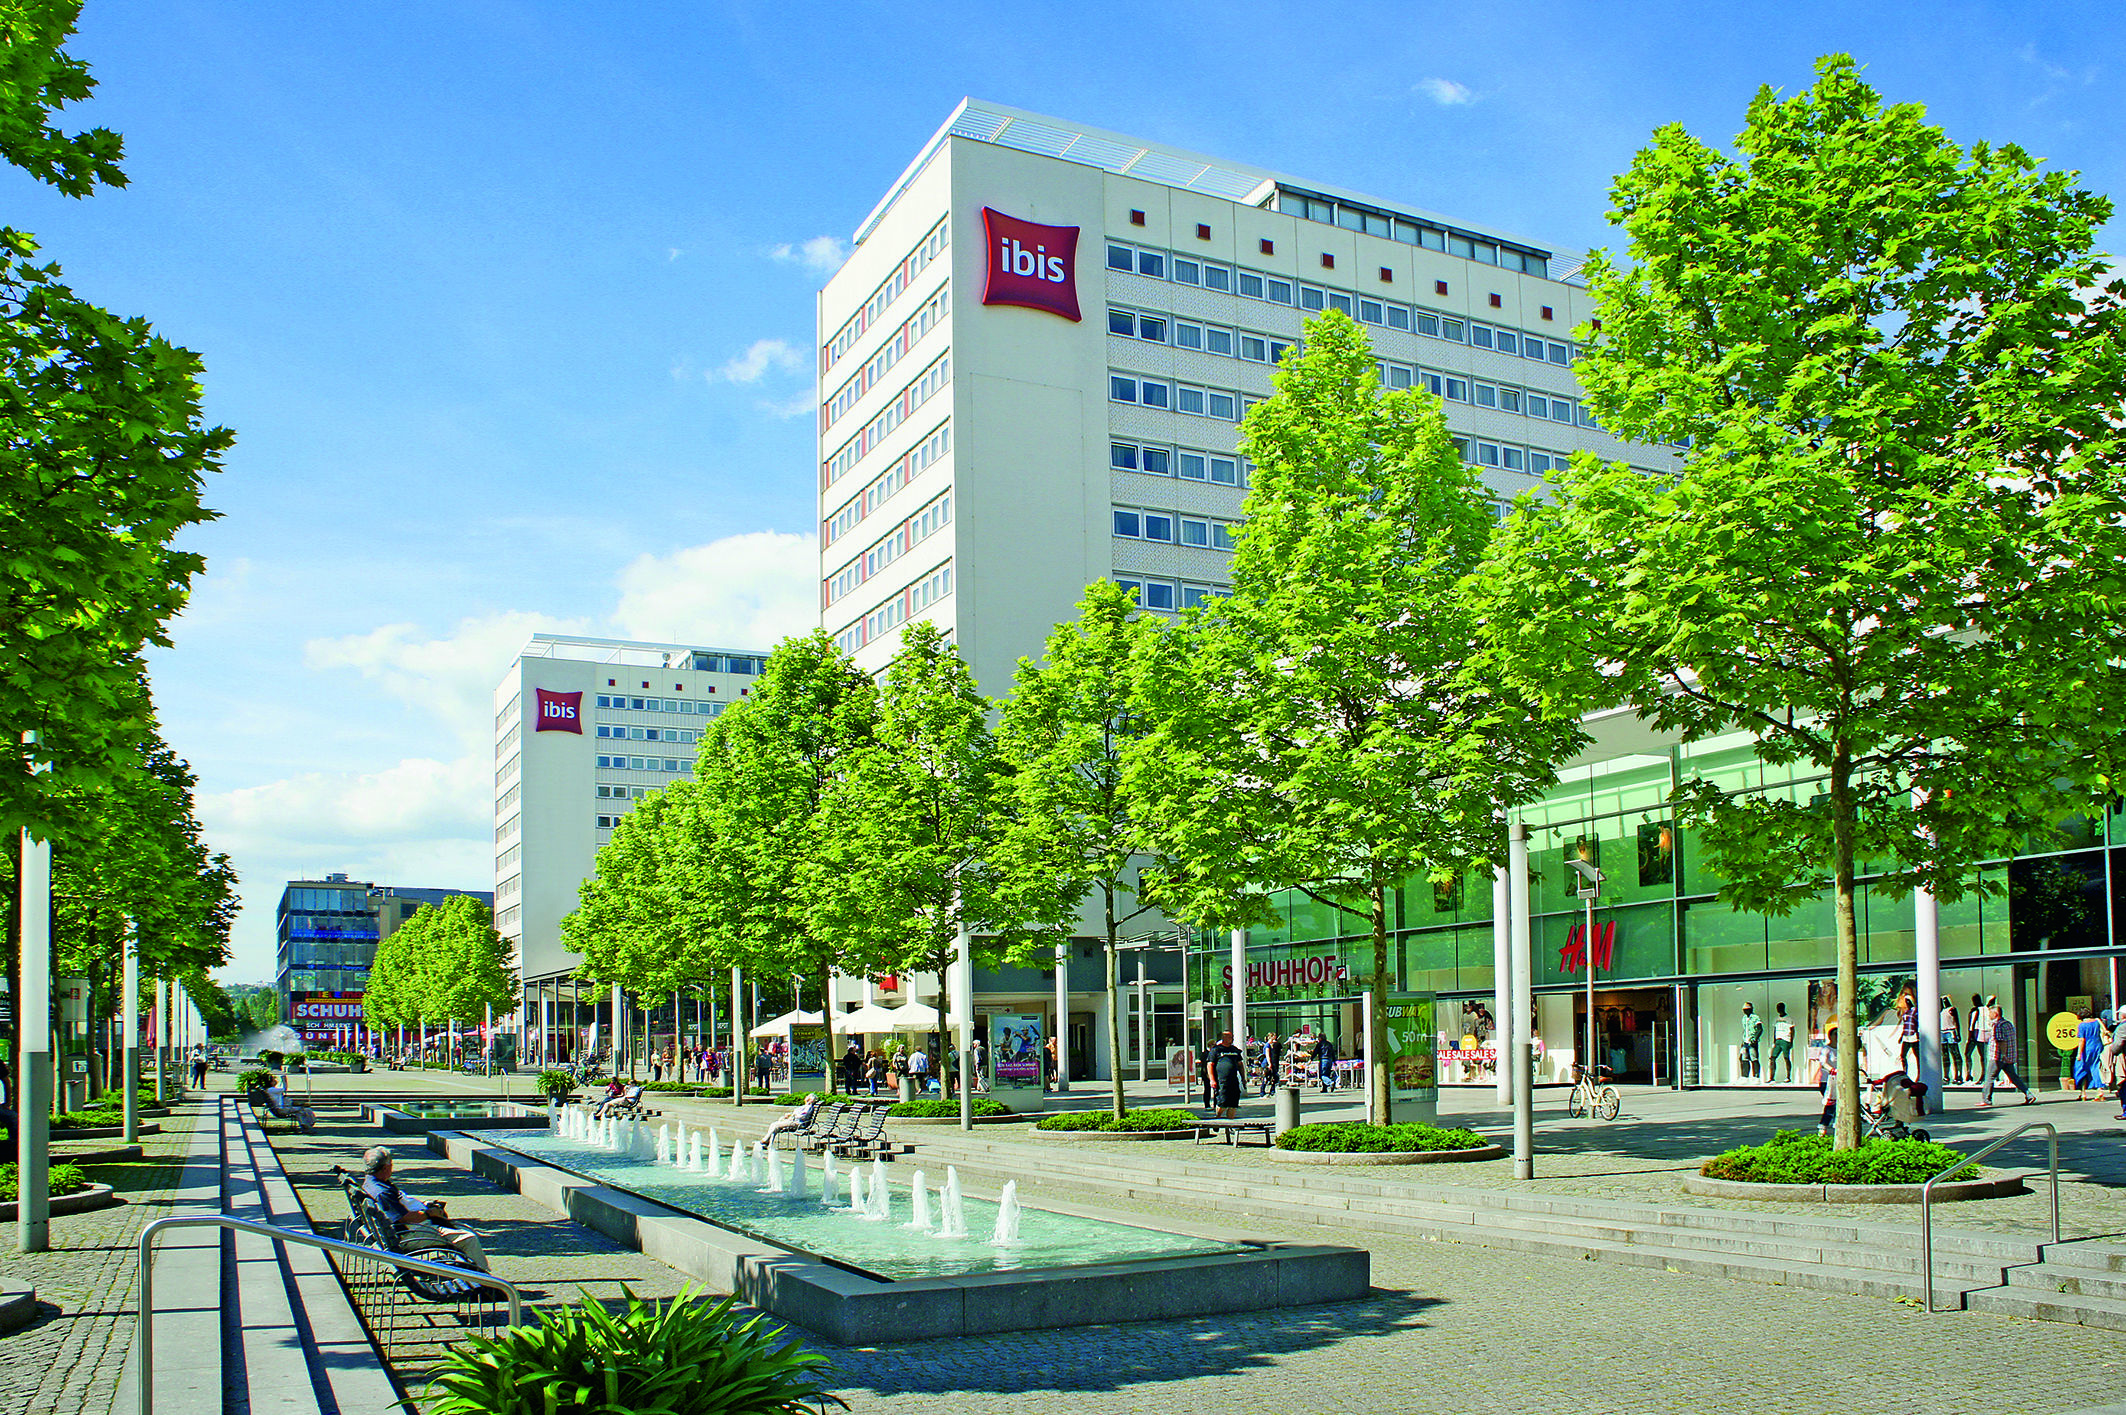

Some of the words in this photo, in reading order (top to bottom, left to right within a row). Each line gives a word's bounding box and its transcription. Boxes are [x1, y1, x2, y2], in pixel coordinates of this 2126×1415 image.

[1001, 237, 1066, 284] ibis
[544, 700, 576, 719] ibis
[1559, 920, 1616, 974] H&M
[1222, 955, 1337, 990] SHUHHOF
[296, 1003, 368, 1017] SCHUH
[1452, 1050, 1470, 1060] SALE
[1470, 1050, 1489, 1060] SALE
